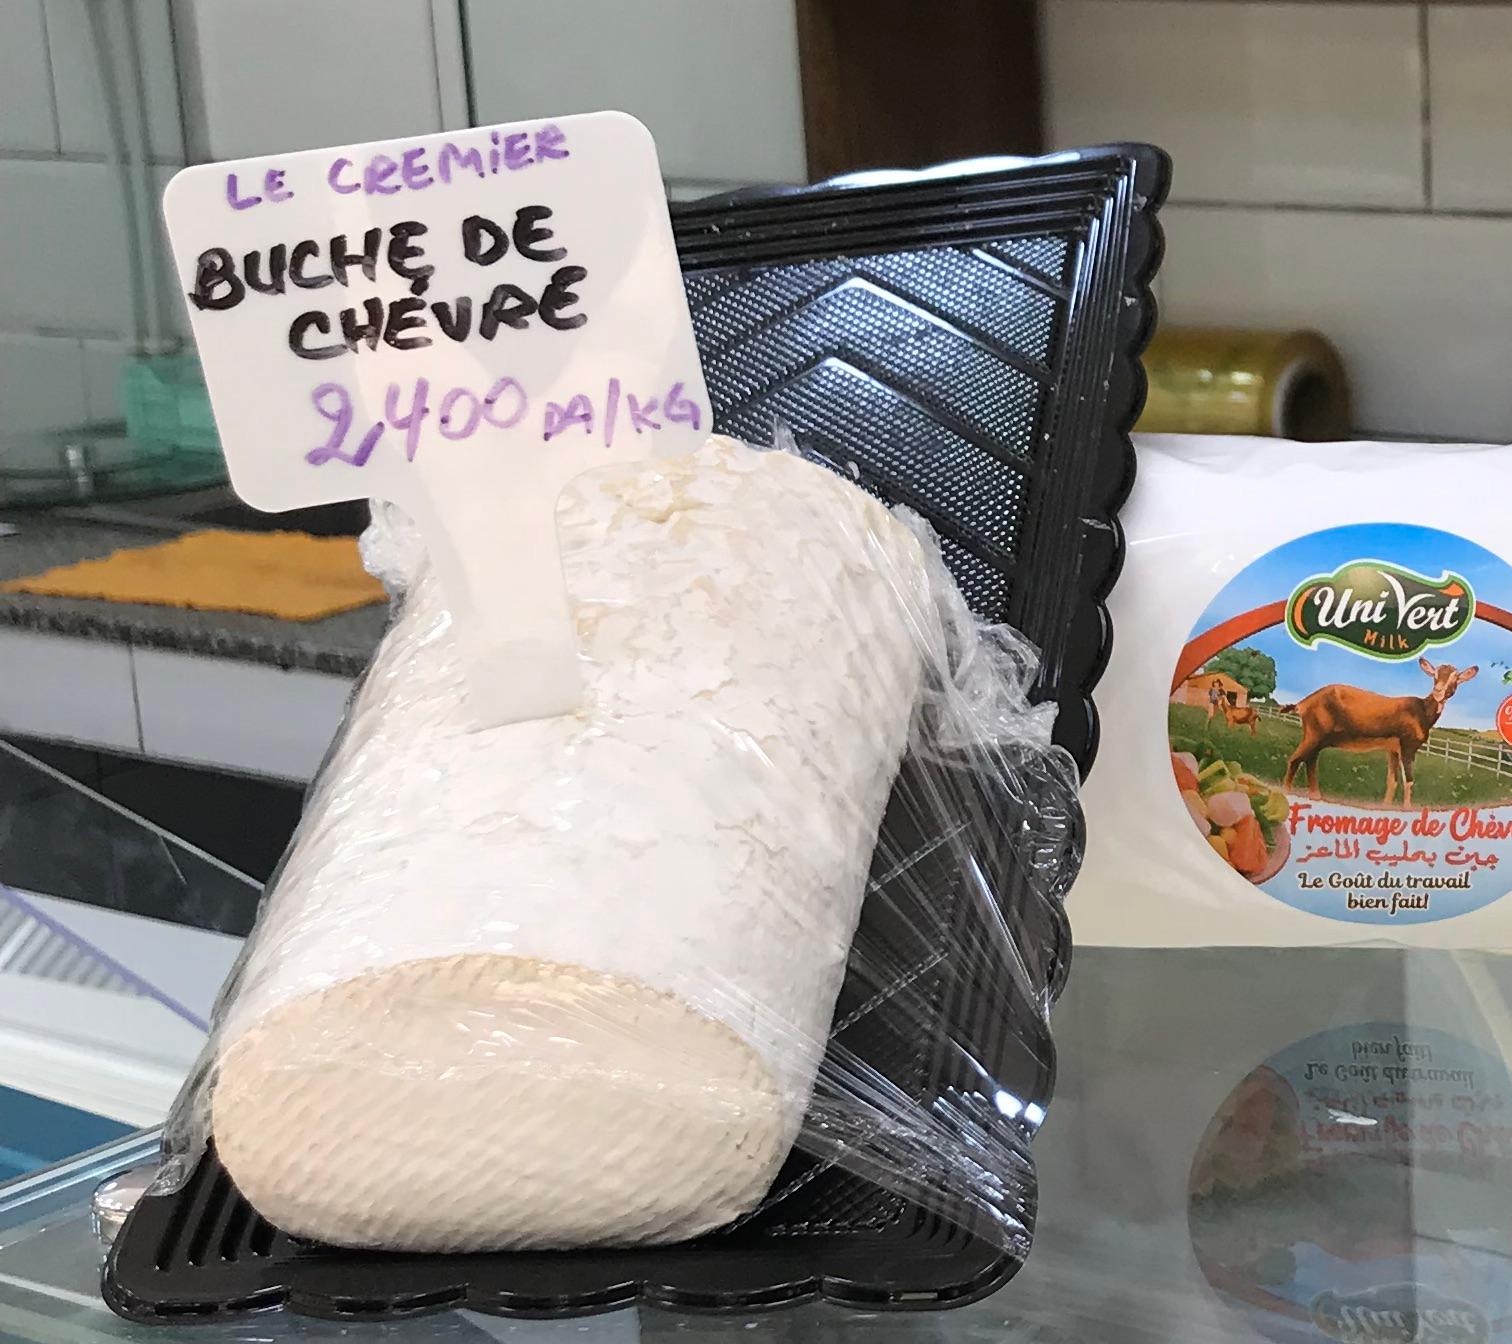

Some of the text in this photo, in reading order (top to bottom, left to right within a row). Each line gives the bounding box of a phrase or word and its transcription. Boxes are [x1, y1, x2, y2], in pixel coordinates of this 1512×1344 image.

[226, 168, 294, 211] LE
[190, 205, 567, 314] BUCHE DE
[1364, 629, 1409, 650] Milk
[1288, 802, 1407, 845] Fromage
[1411, 808, 1446, 838] de
[1298, 872, 1471, 890] Le Goût du travail
[1347, 892, 1430, 915] bien fait!
